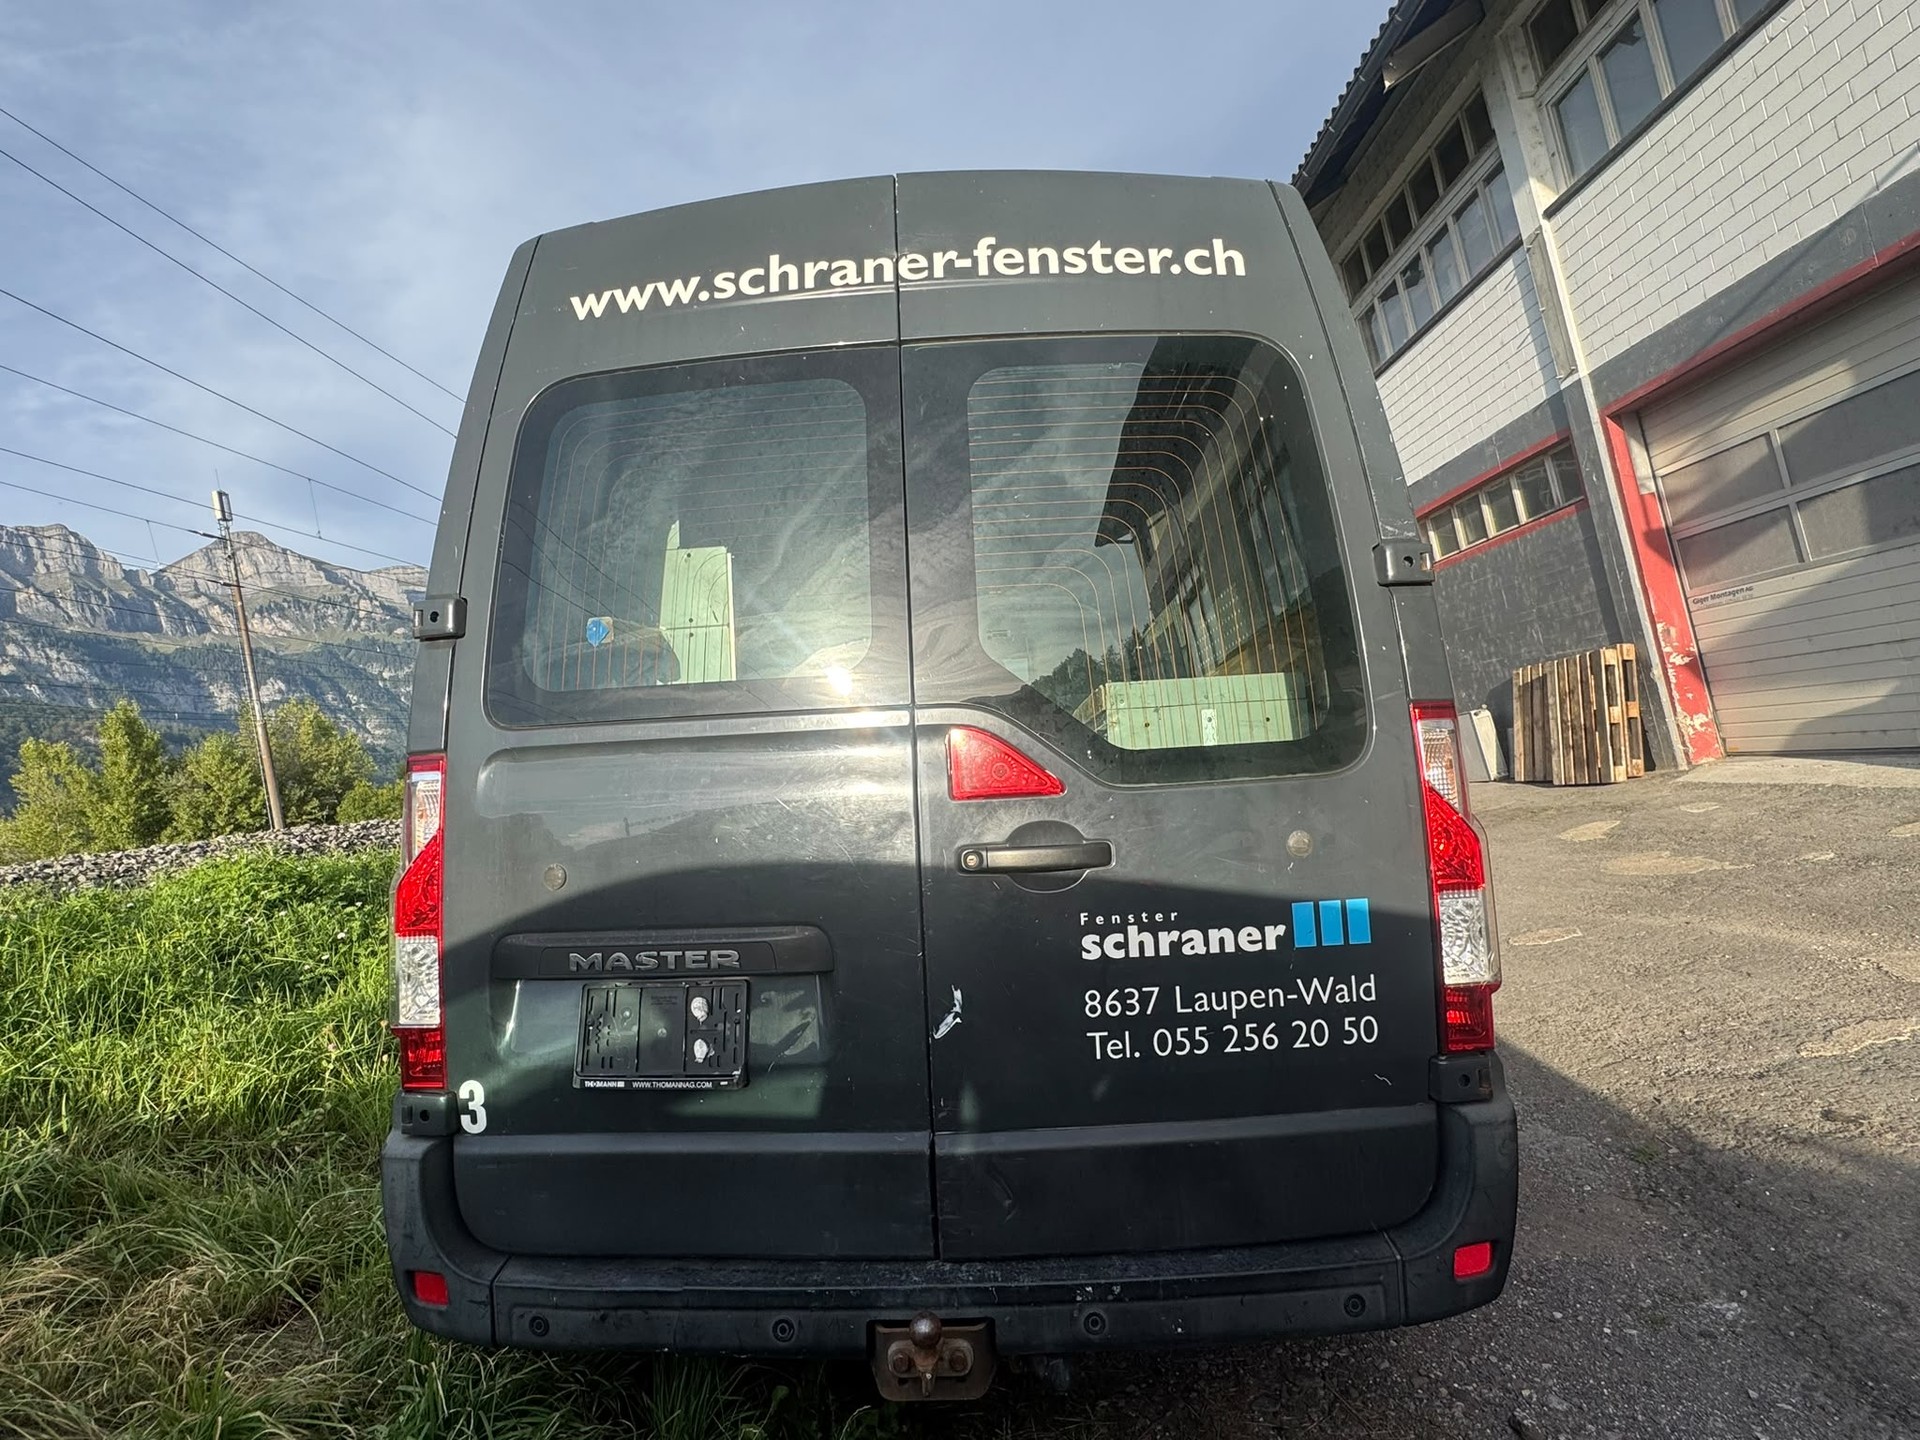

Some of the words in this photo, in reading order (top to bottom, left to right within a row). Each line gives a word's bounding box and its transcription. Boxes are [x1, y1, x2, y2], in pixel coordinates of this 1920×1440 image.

[569, 236, 1246, 322] www.schraner-fenster.ch
[1710, 587, 1745, 600] Montagen
[1080, 911, 1178, 925] Fenster
[568, 949, 741, 973] MASTER
[1080, 923, 1287, 961] schraner
[1084, 986, 1161, 1019] 8637
[1174, 973, 1377, 1020] Laupen-Wald
[1086, 1030, 1141, 1061] Tel.
[1153, 1025, 1210, 1057] 055
[1222, 1021, 1280, 1054] 256
[1291, 1018, 1330, 1049] 20
[1342, 1015, 1379, 1046] 50
[632, 1080, 713, 1090] WWW.THOMANNAG.COM
[458, 1079, 488, 1135] 3
